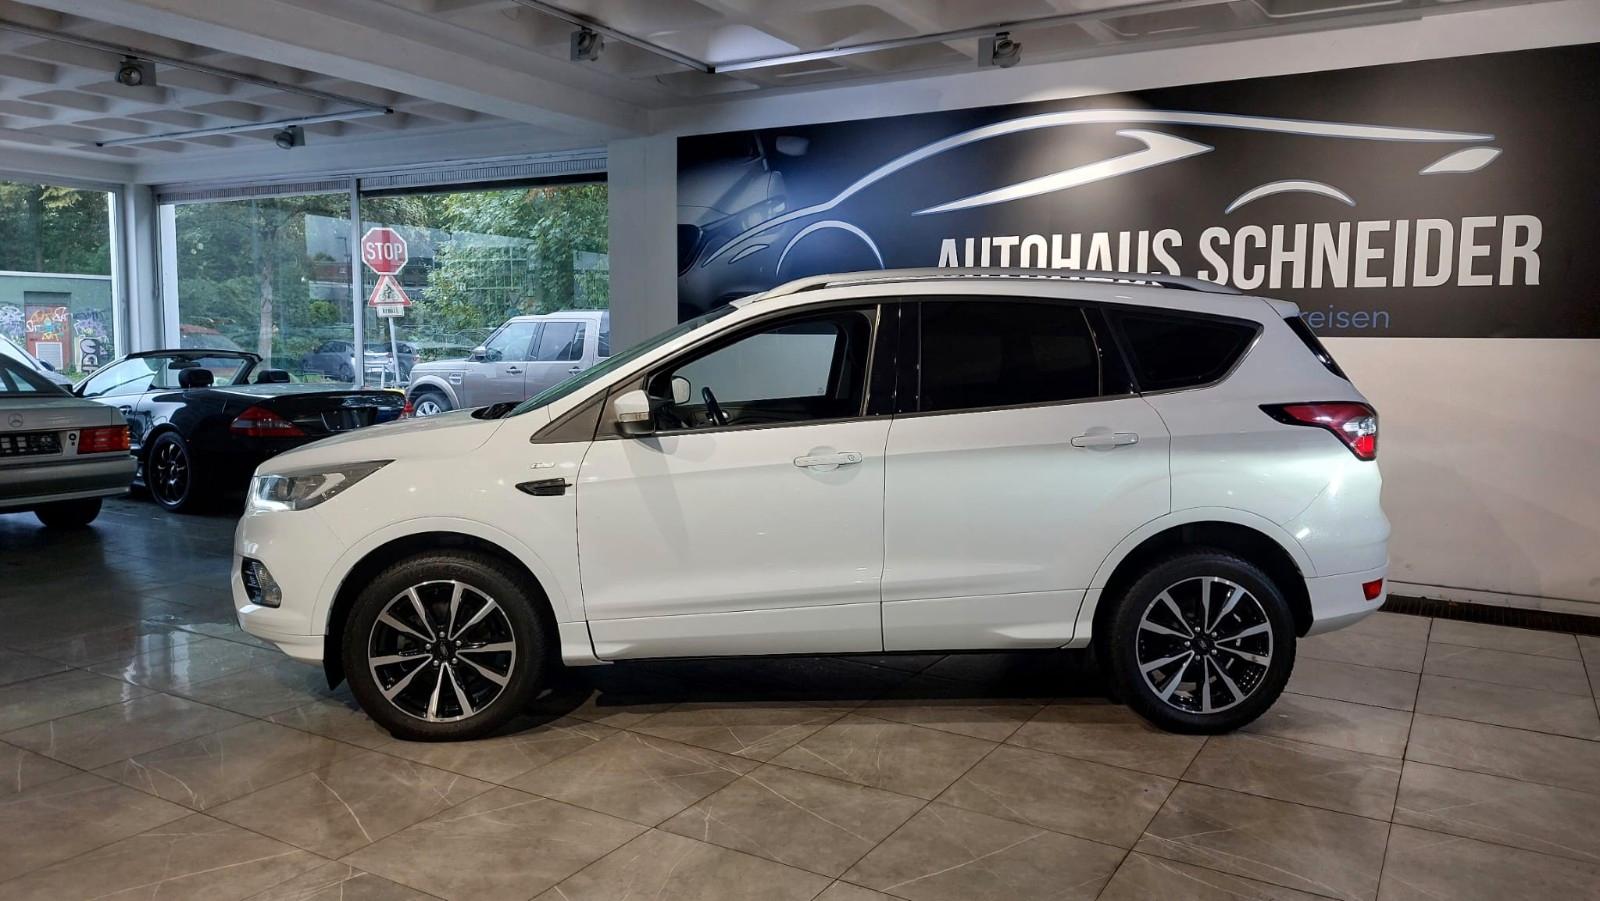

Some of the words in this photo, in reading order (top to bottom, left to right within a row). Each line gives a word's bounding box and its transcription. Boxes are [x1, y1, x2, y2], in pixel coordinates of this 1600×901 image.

[366, 242, 403, 260] STOP
[938, 229, 1183, 277] AUTOHAUS
[1197, 214, 1543, 290] SCHNEIDER
